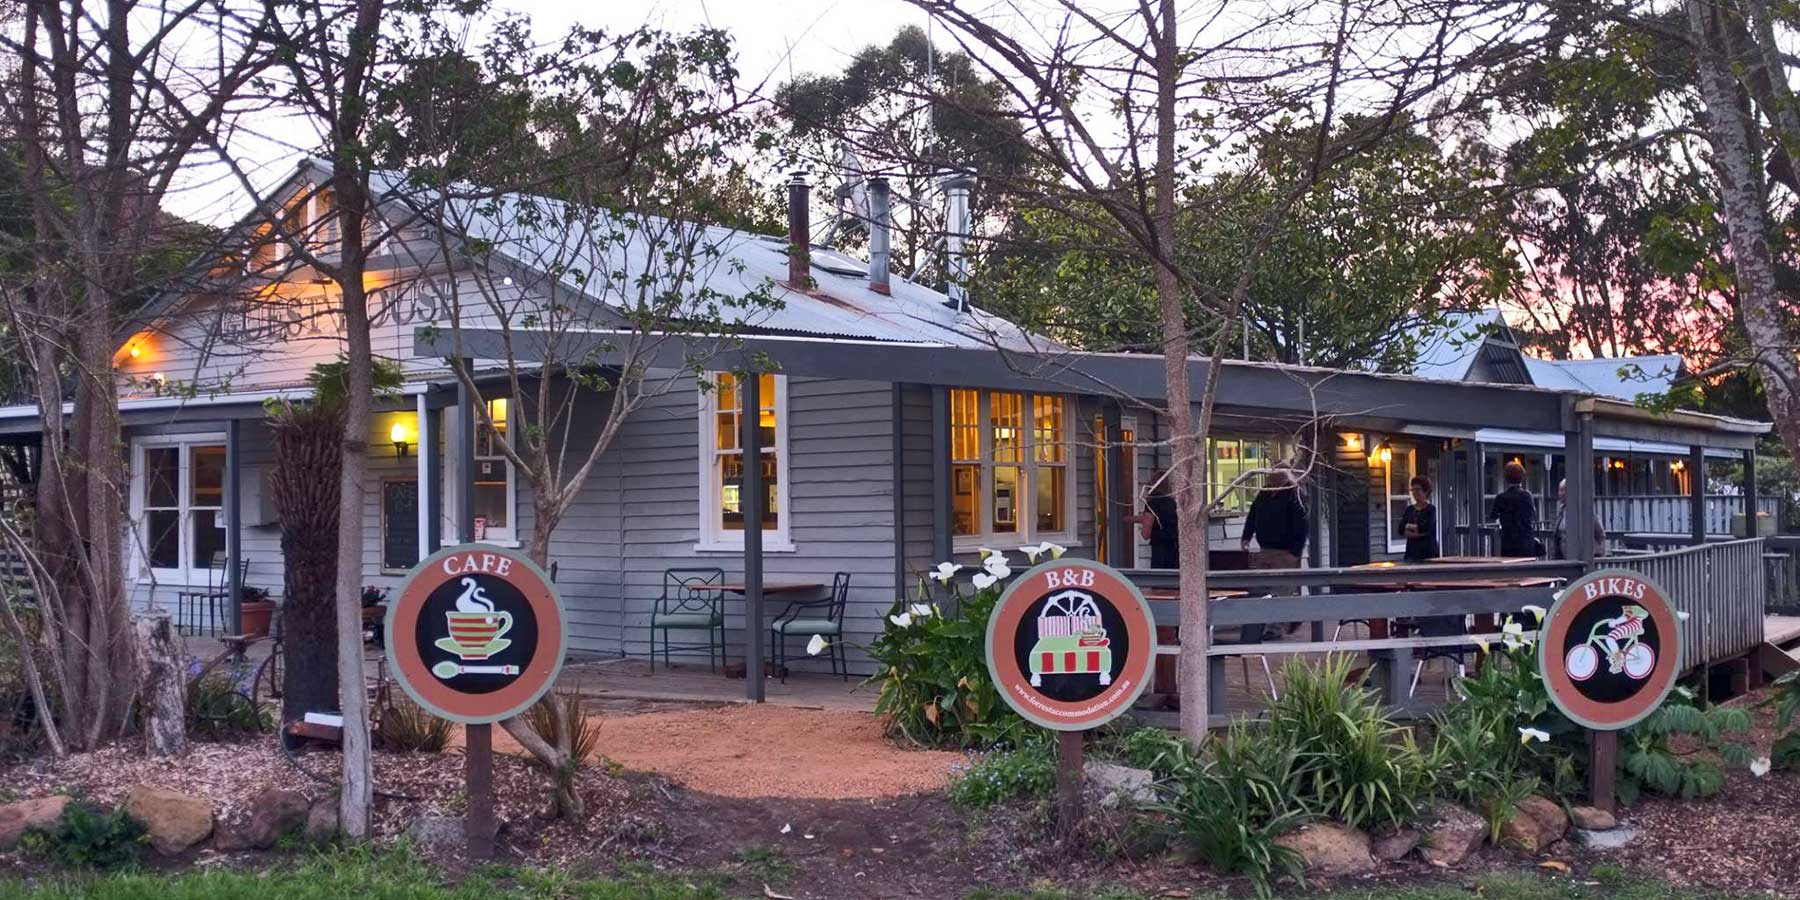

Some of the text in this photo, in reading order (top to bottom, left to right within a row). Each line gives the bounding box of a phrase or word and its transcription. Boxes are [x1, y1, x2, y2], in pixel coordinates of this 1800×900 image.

[443, 554, 512, 576] CAFE
[1045, 568, 1095, 589] B&B
[1584, 577, 1646, 600] BIKES
